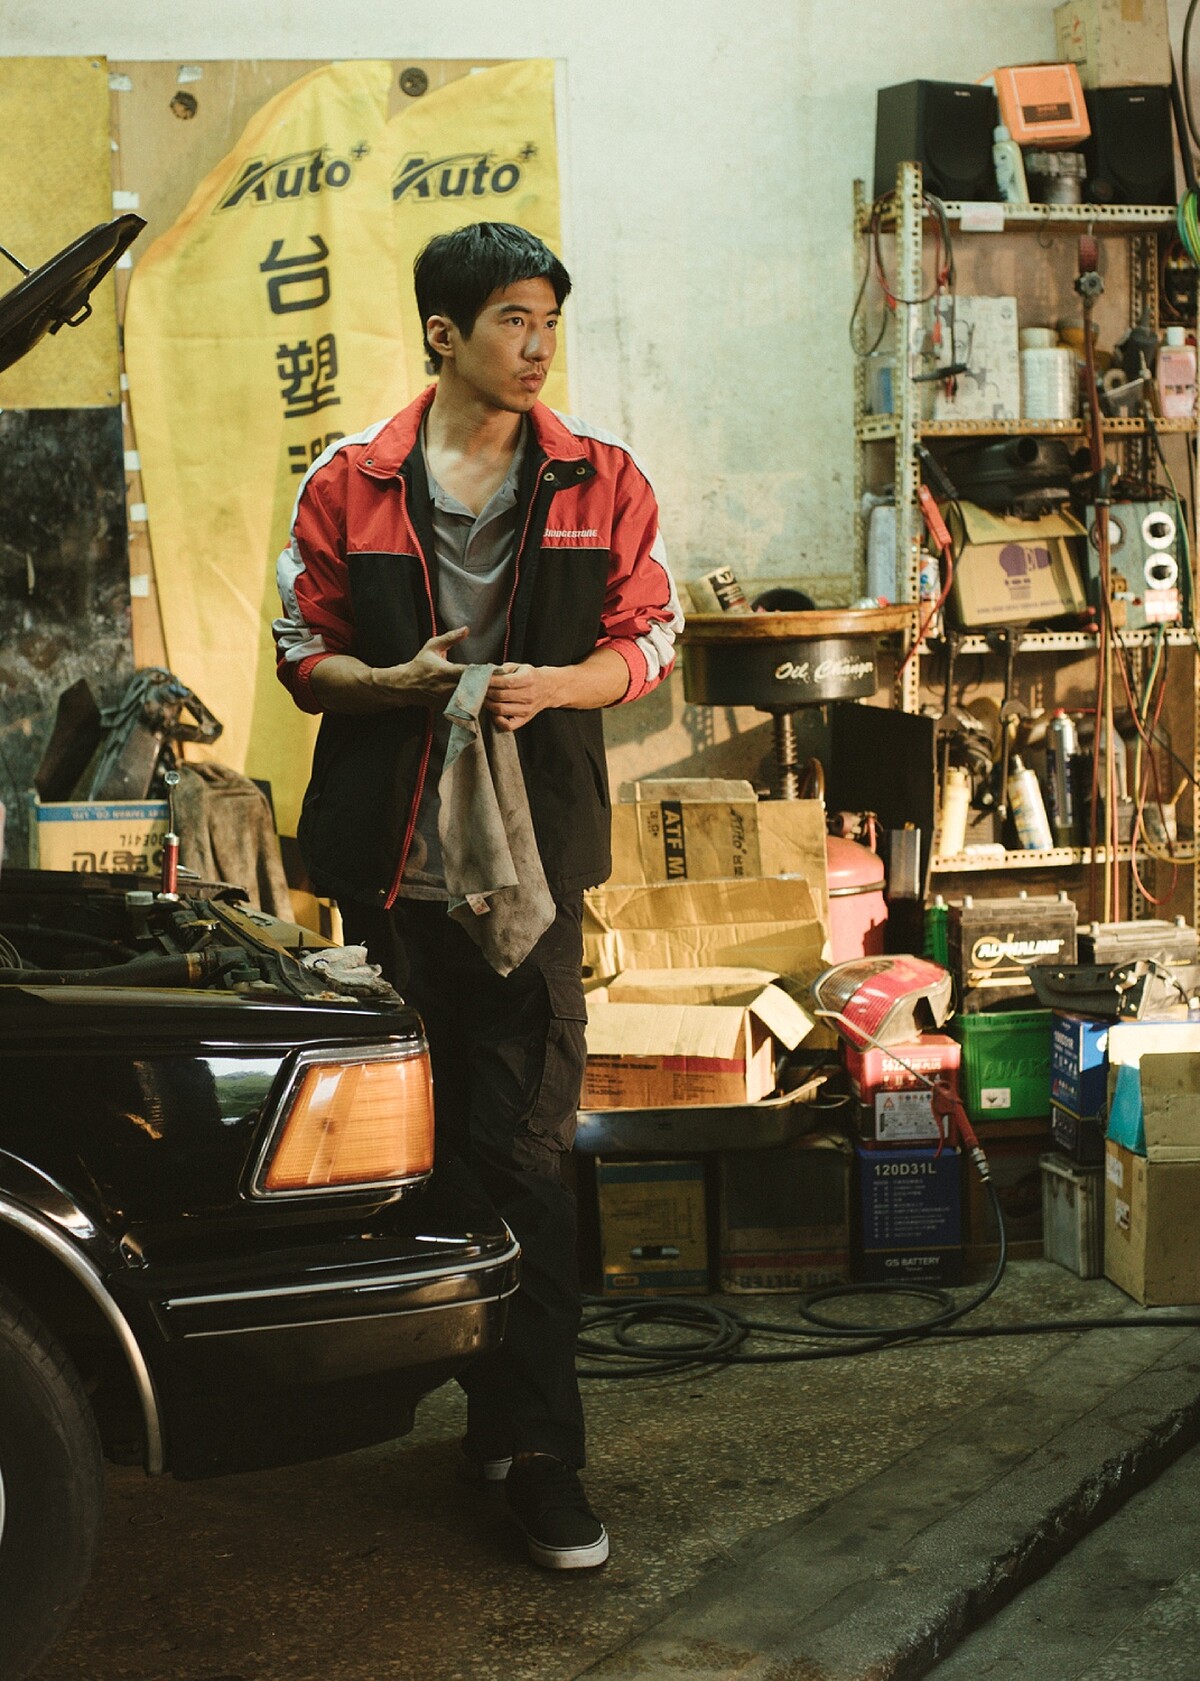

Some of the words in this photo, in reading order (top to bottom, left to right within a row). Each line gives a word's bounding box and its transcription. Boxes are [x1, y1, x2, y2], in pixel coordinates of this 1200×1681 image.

[664, 810, 683, 851] ATF
[978, 939, 1062, 958] ALPHALINE
[874, 1163, 937, 1176] 120D31L
[901, 1257, 940, 1267] BATTERY
